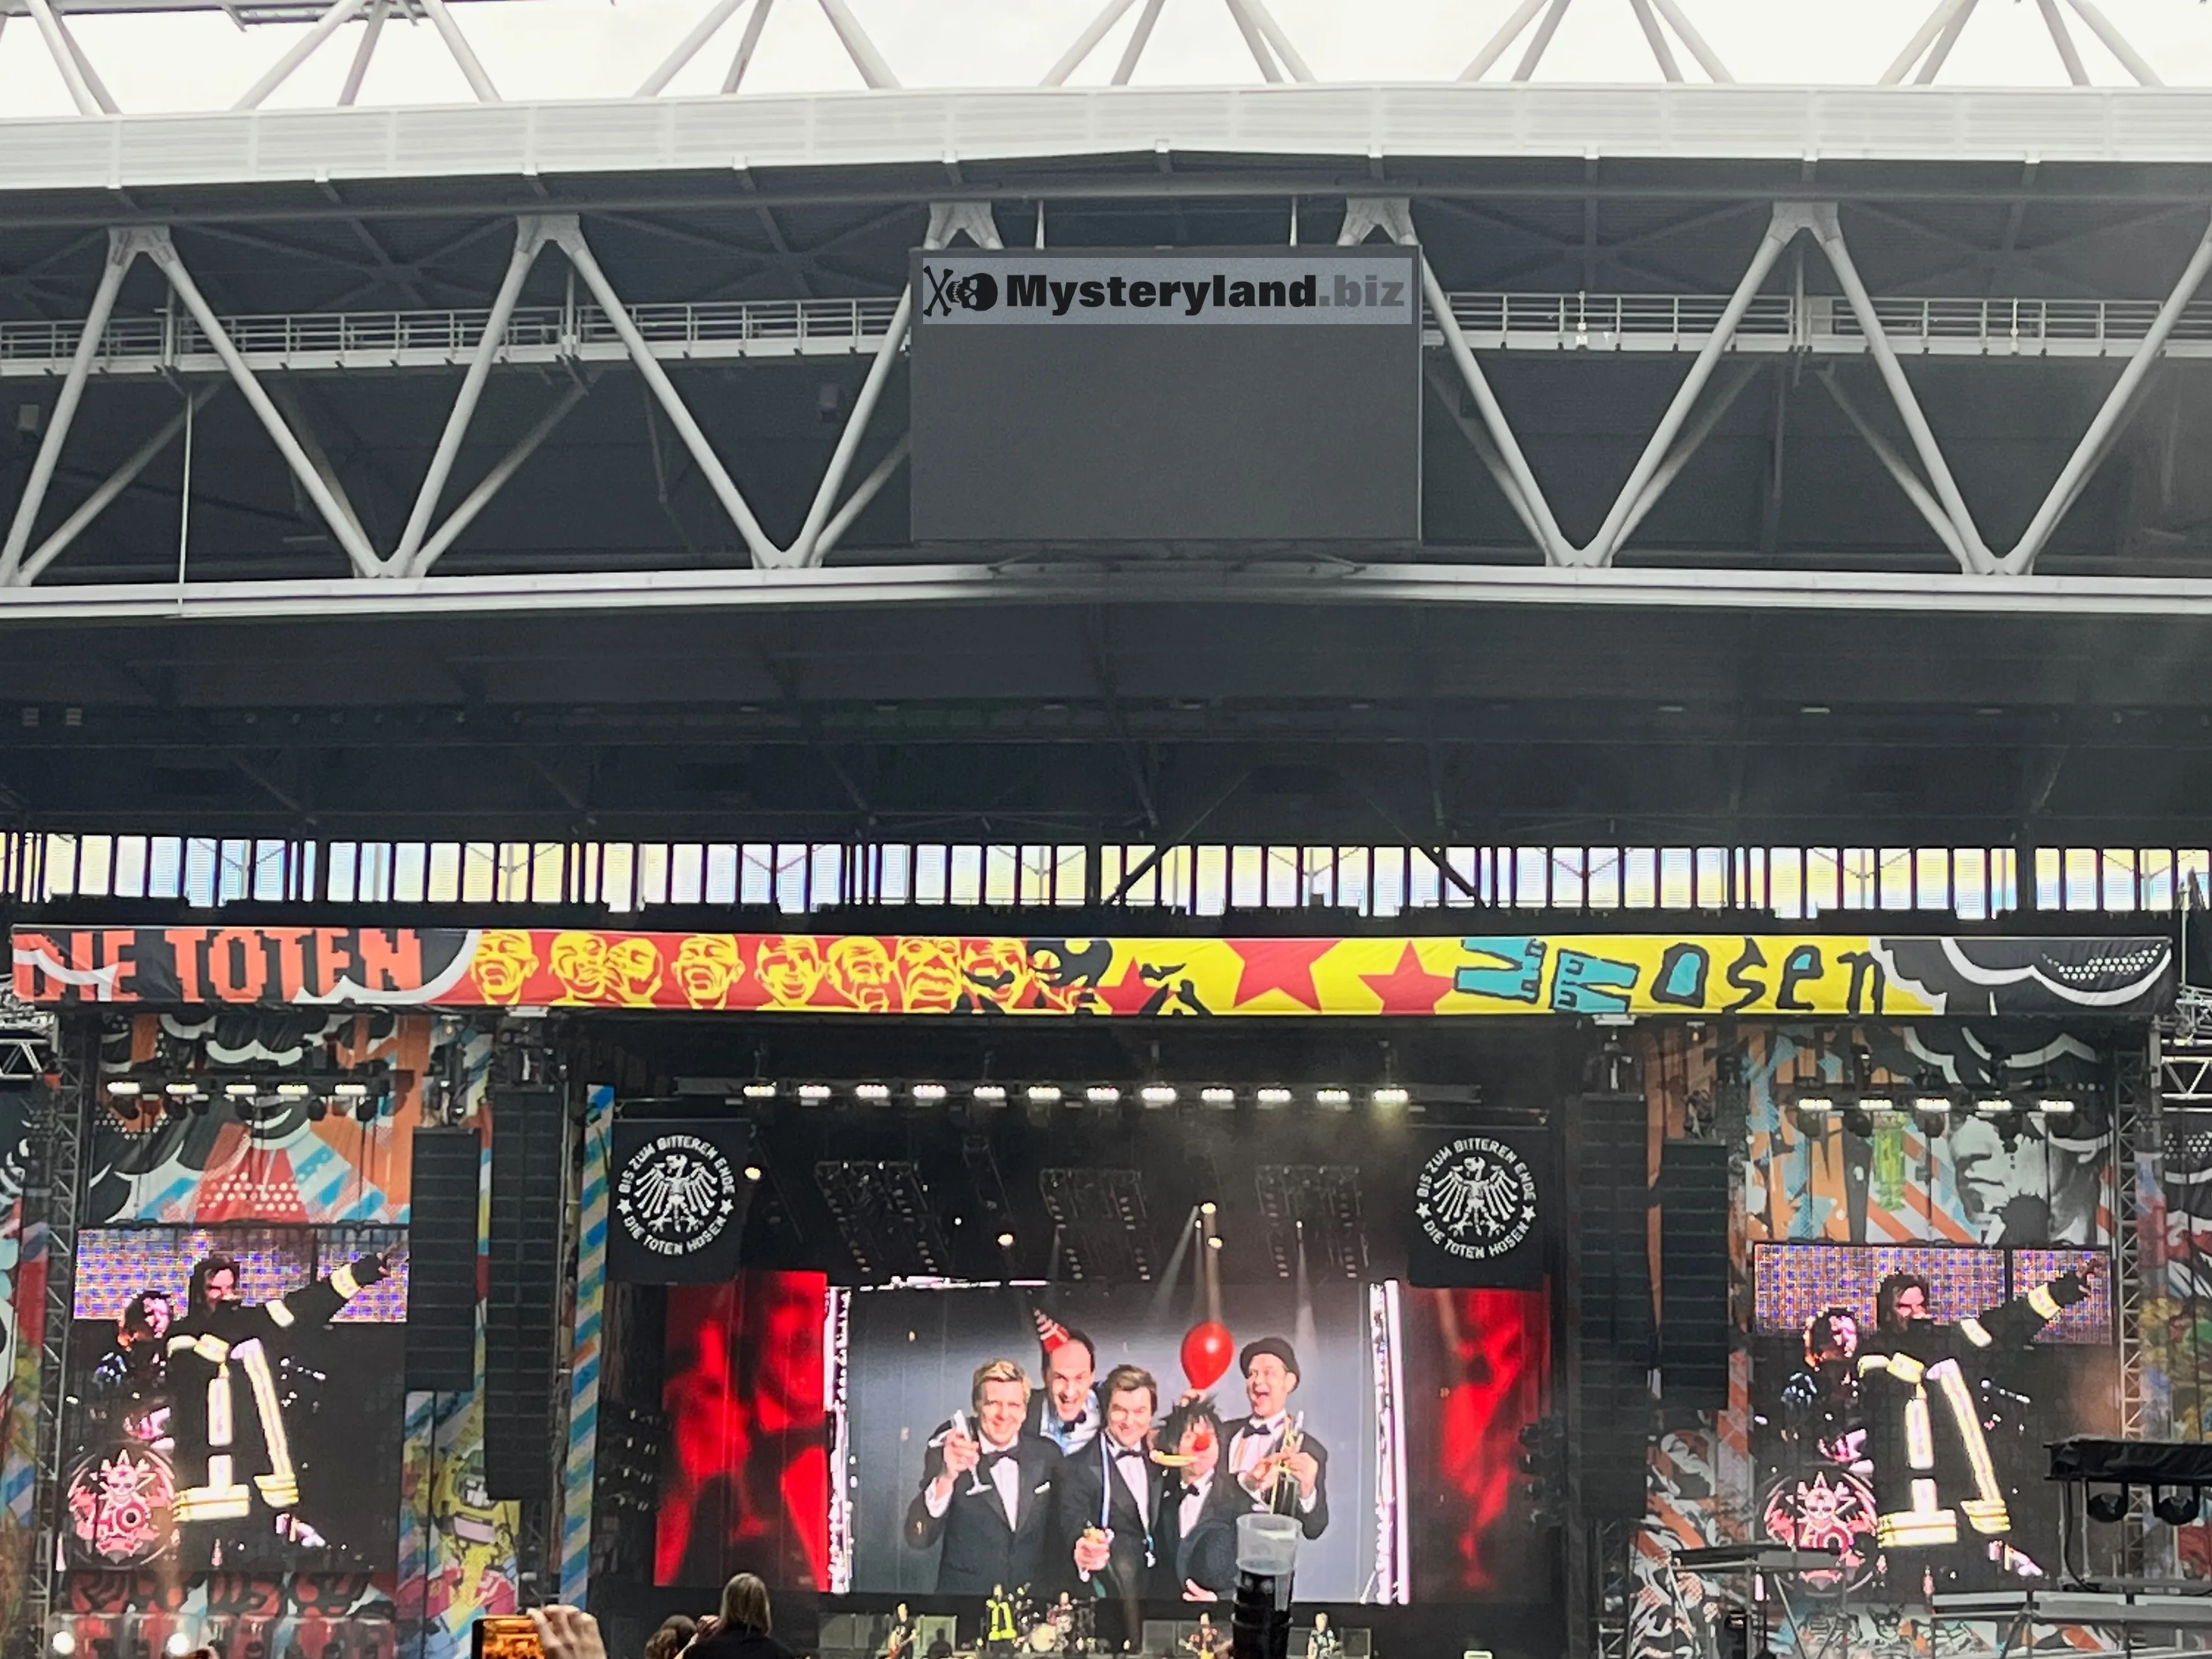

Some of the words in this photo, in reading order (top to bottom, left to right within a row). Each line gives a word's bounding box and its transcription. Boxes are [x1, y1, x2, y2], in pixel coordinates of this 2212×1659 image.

[12, 929, 142, 1002] DIE
[164, 927, 422, 1003] TOTEN
[618, 1170, 635, 1194] BIS
[628, 1143, 656, 1170] ZUM
[656, 1135, 718, 1160] BITTEREN
[714, 1157, 736, 1194] ENDE
[1416, 1173, 1433, 1197] BIS
[1425, 1145, 1453, 1173] ZUM
[1453, 1138, 1518, 1163] BITTEREN
[1513, 1162, 1537, 1201] ENDE
[624, 1215, 646, 1240] DIE
[643, 1234, 684, 1255] TOTEN
[686, 1215, 727, 1253] HOSEN
[1423, 1220, 1446, 1245] DIE
[1444, 1238, 1485, 1259] TOTEN
[1488, 1221, 1530, 1257] HOSEN
